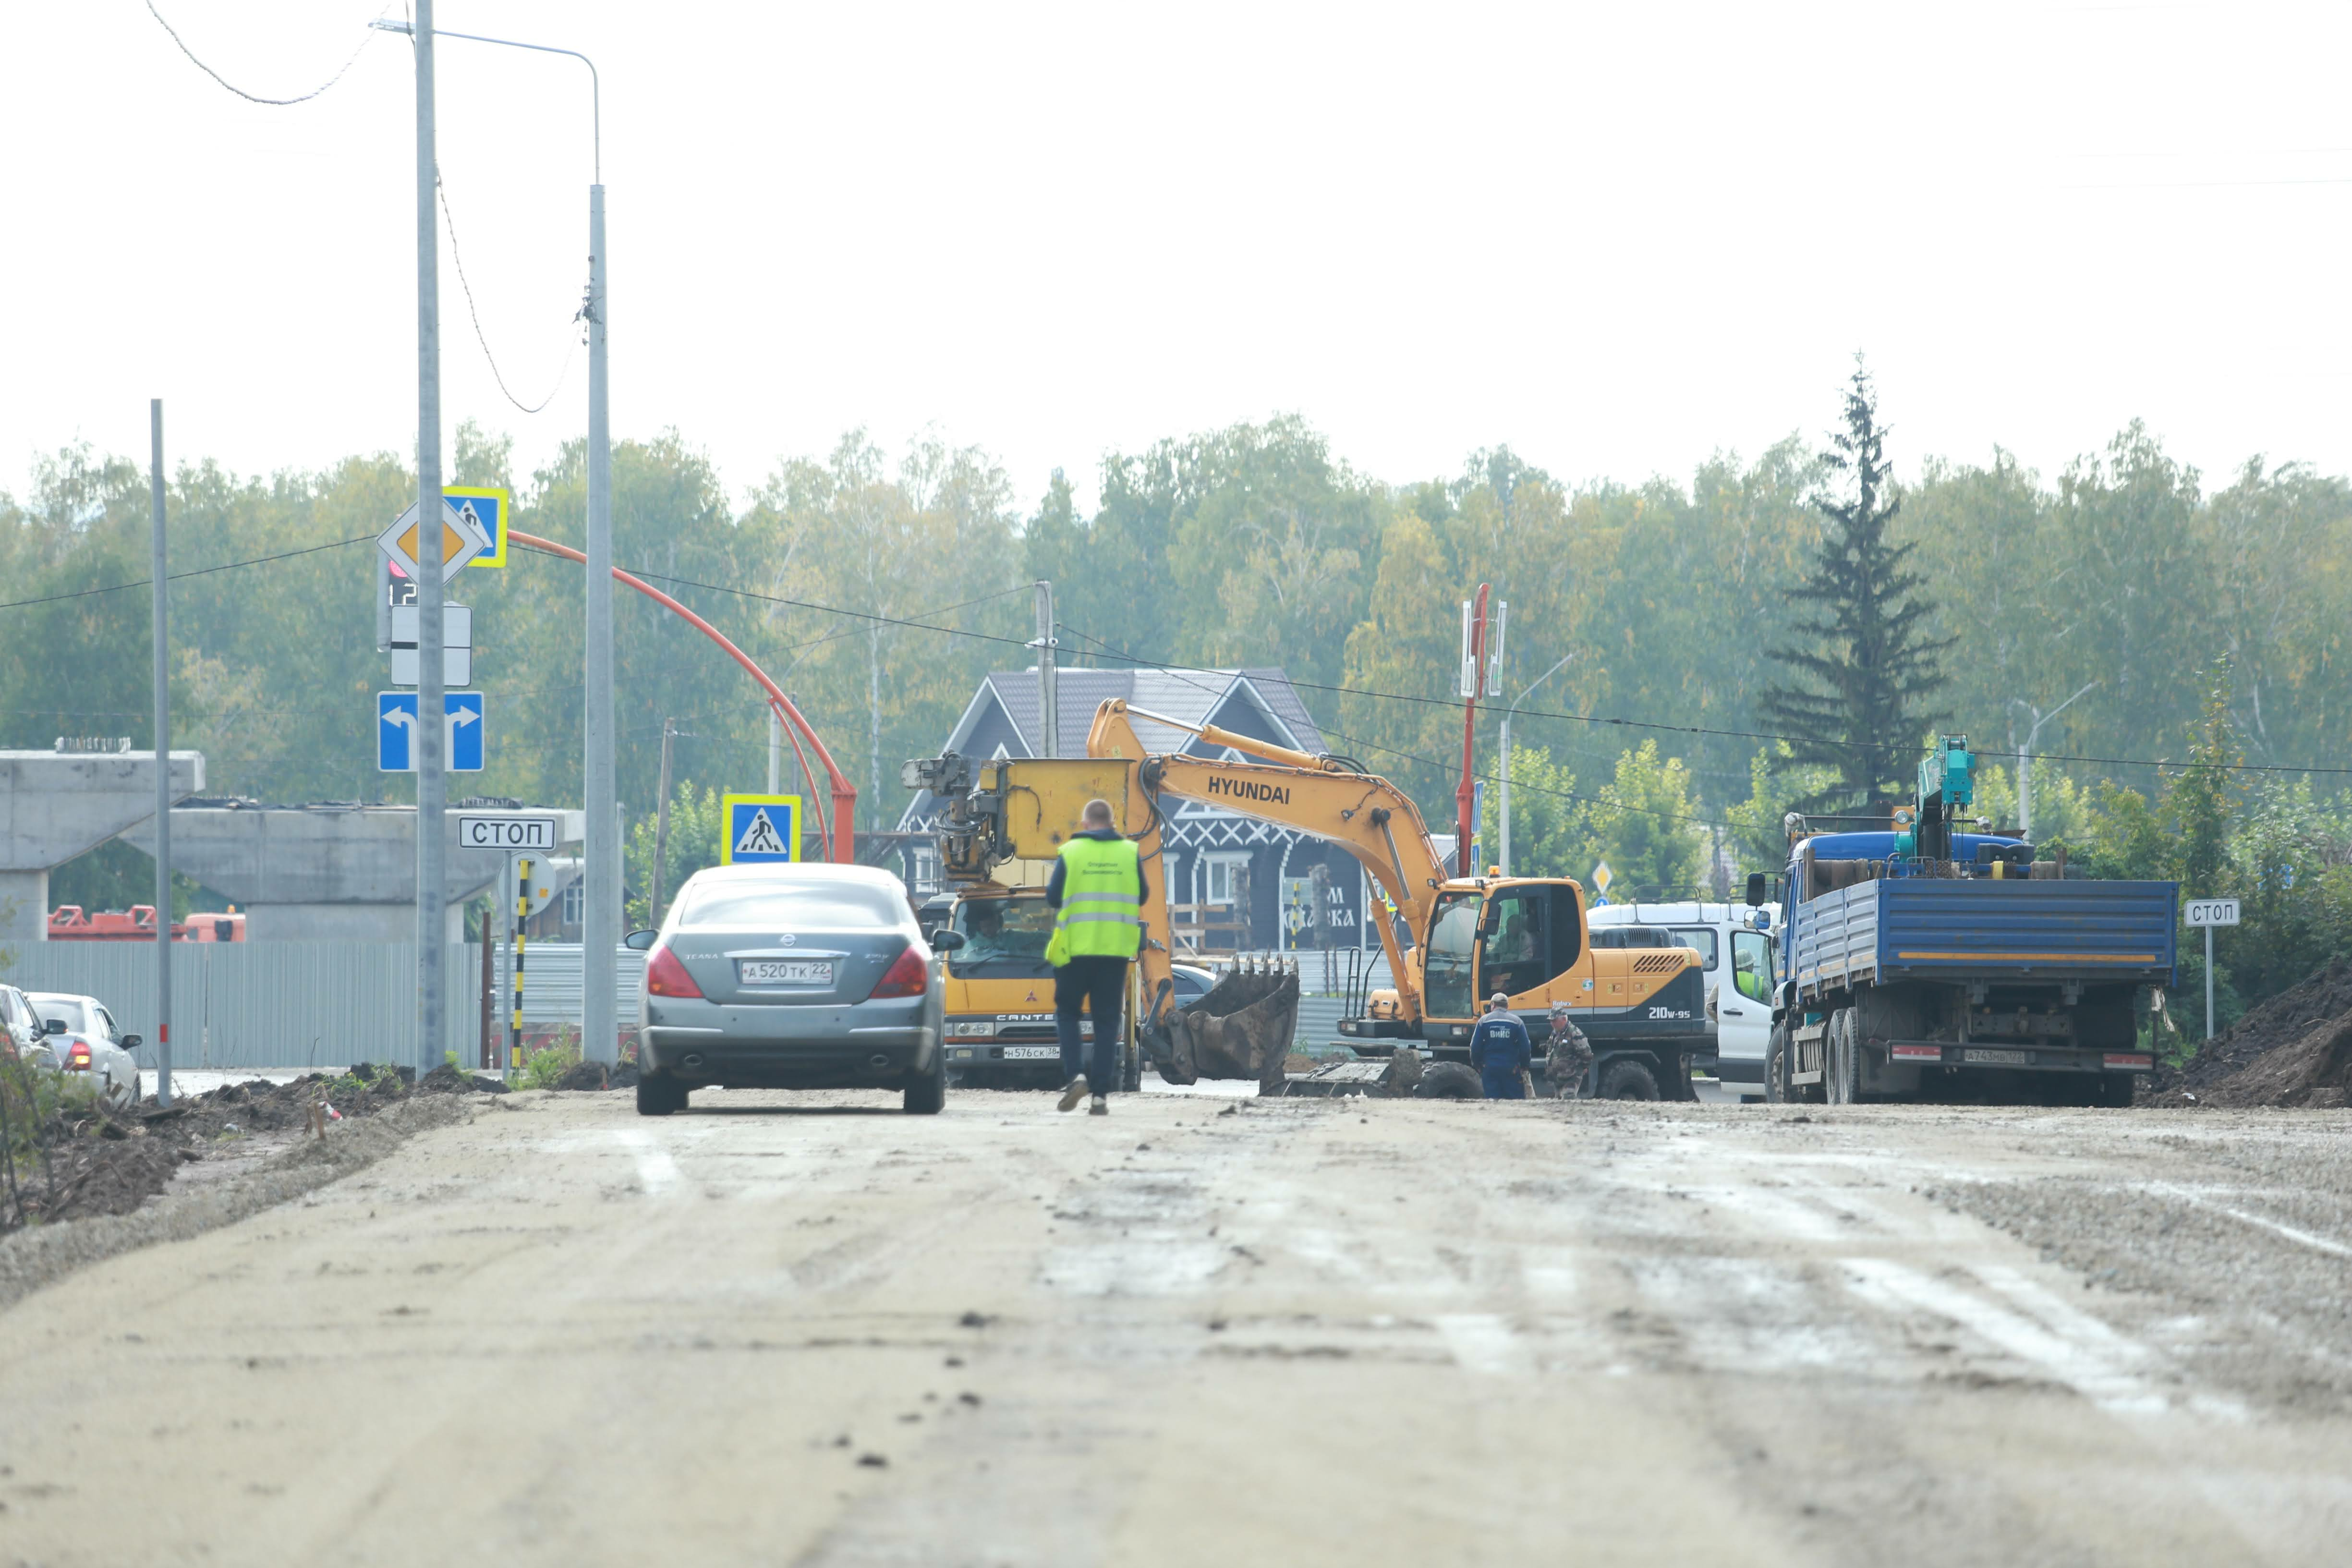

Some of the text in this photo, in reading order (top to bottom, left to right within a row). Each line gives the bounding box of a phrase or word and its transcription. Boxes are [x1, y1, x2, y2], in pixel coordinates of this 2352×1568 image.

[389, 583, 417, 606] 12
[1208, 776, 1290, 804] HYUNDAI
[473, 822, 542, 844] СТОП
[2193, 904, 2232, 921] СТОП
